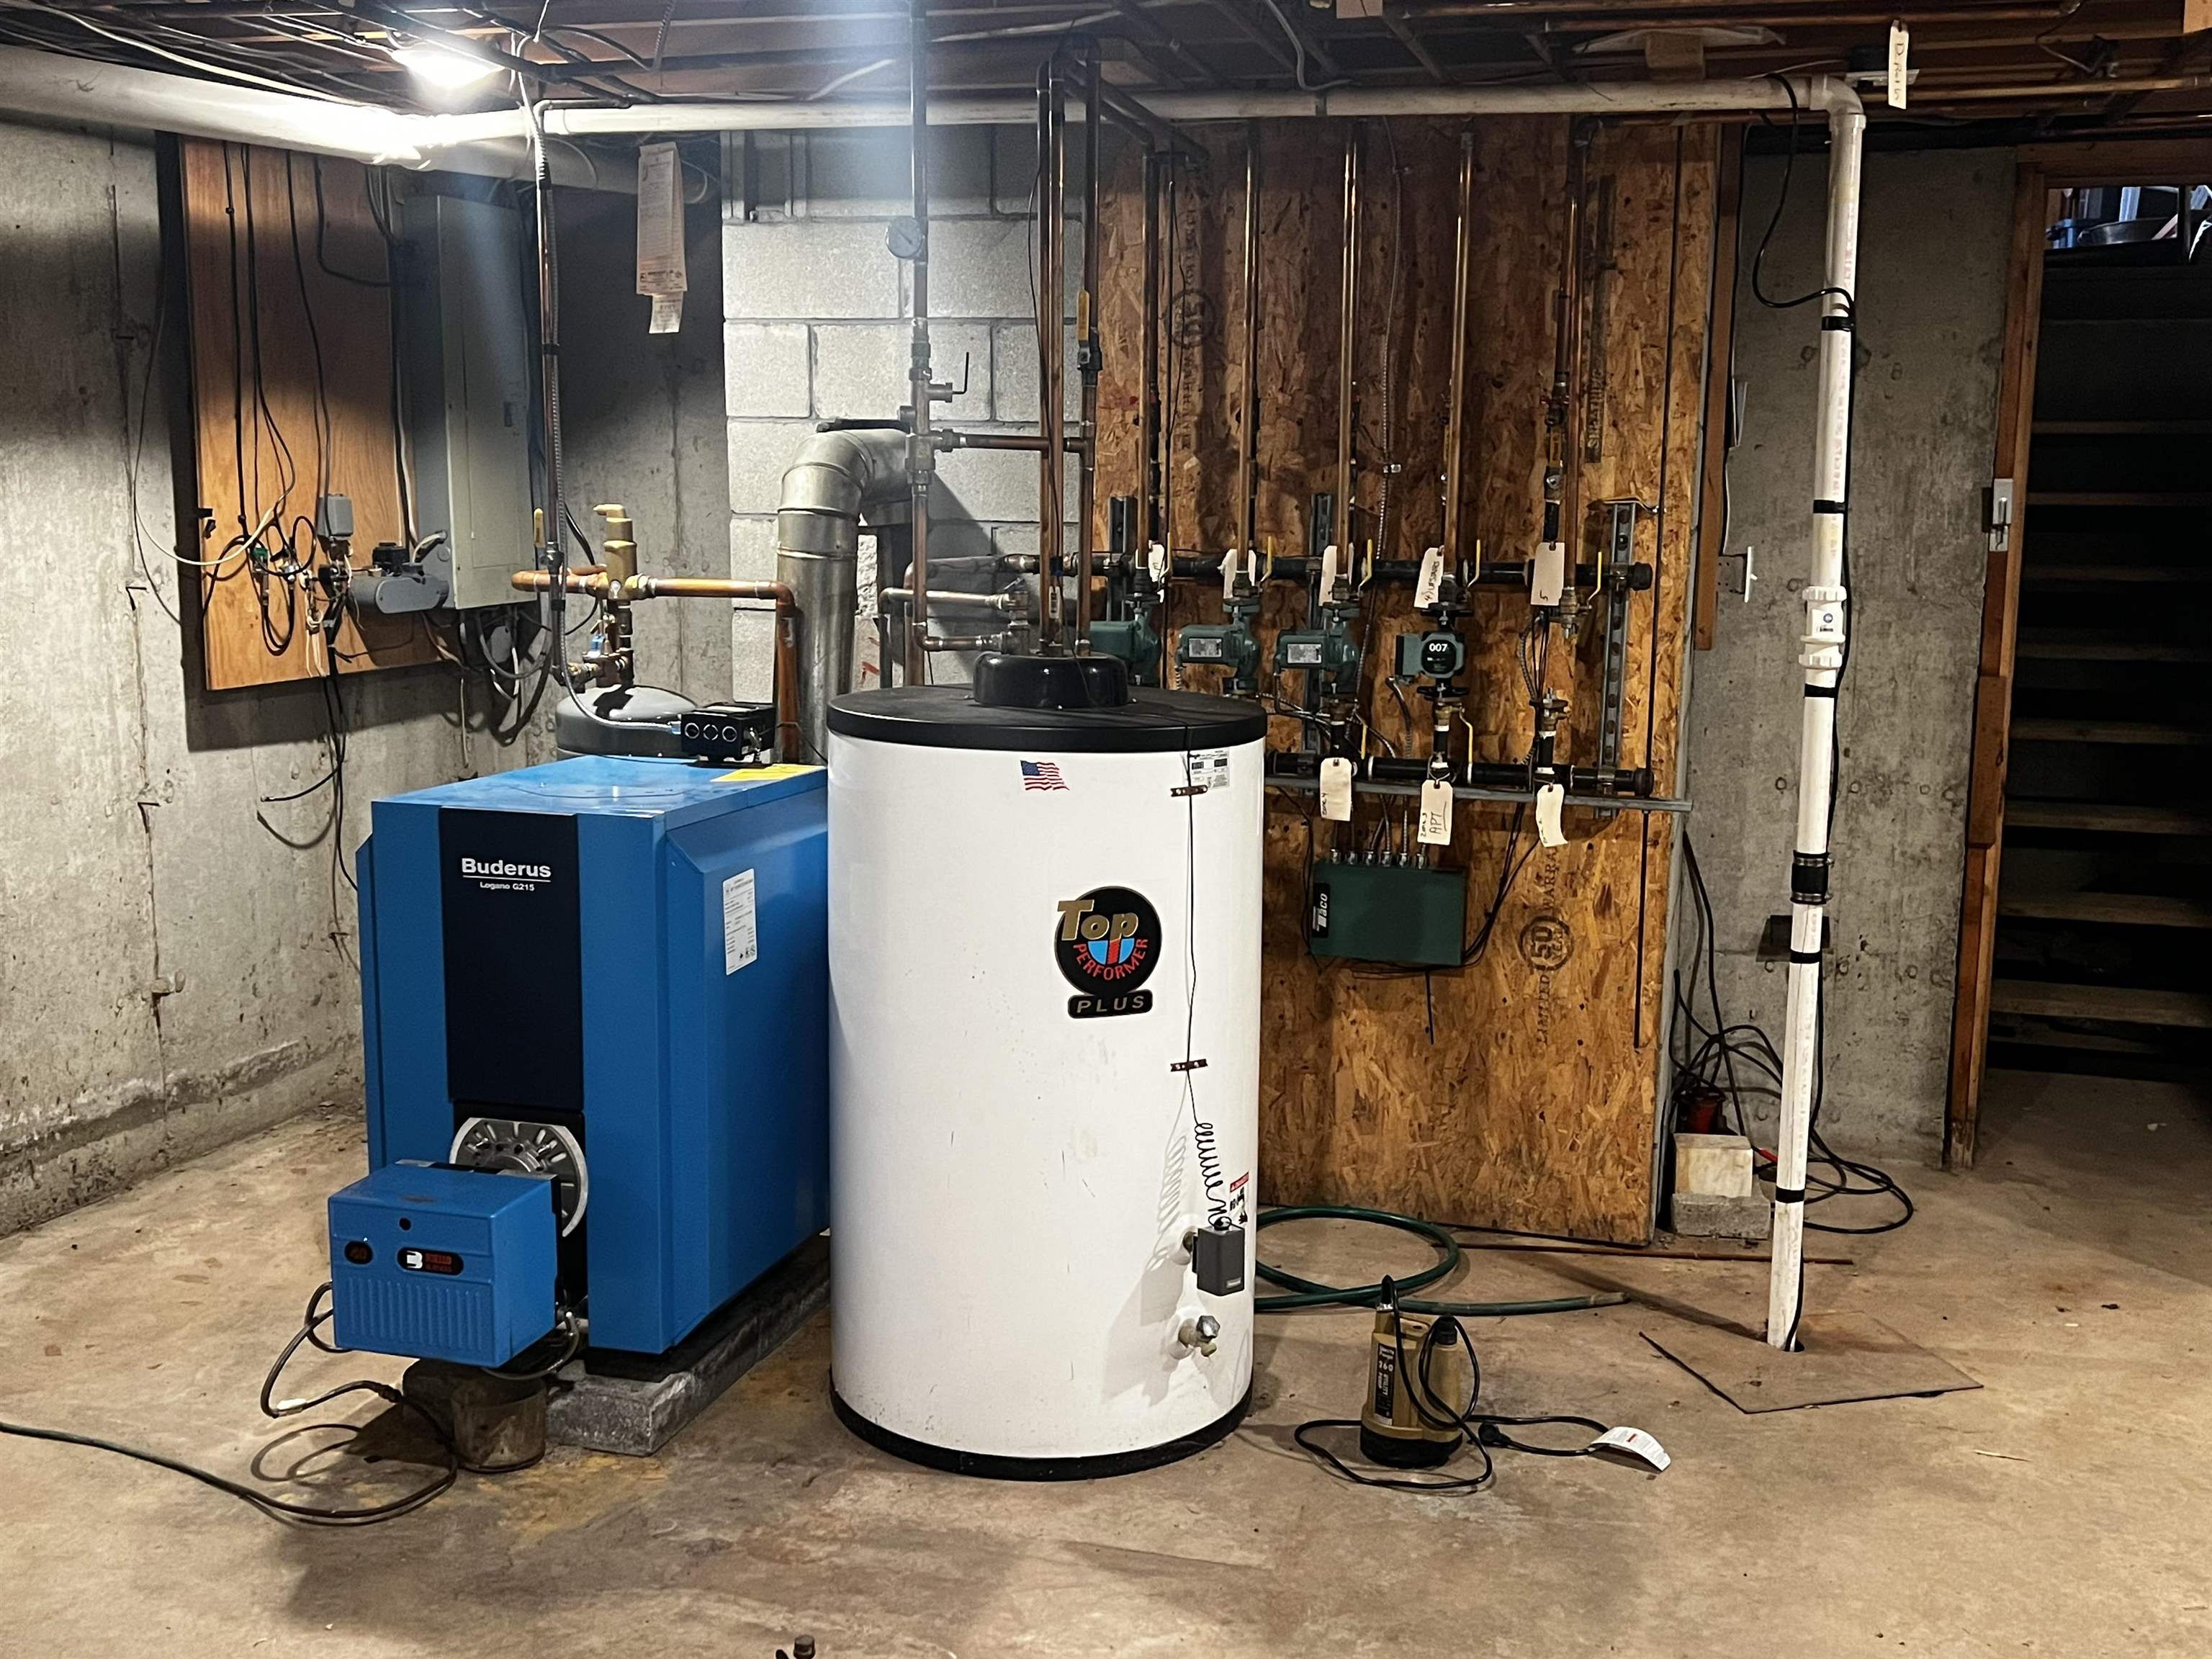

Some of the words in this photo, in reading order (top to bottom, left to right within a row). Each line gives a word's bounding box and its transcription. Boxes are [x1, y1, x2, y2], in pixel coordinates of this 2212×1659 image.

[1429, 642, 1448, 652] 007
[1429, 811, 1442, 835] APT
[462, 858, 552, 878] Buderus
[1544, 846, 1557, 910] WARRA
[480, 881, 511, 891] Logano
[512, 882, 535, 891] G215
[1057, 899, 1139, 943] Top
[1530, 925, 1552, 960] 50
[1073, 938, 1148, 981] PERFORMER
[1076, 995, 1145, 1014] PLUS
[1536, 974, 1550, 1046] LIMITED
